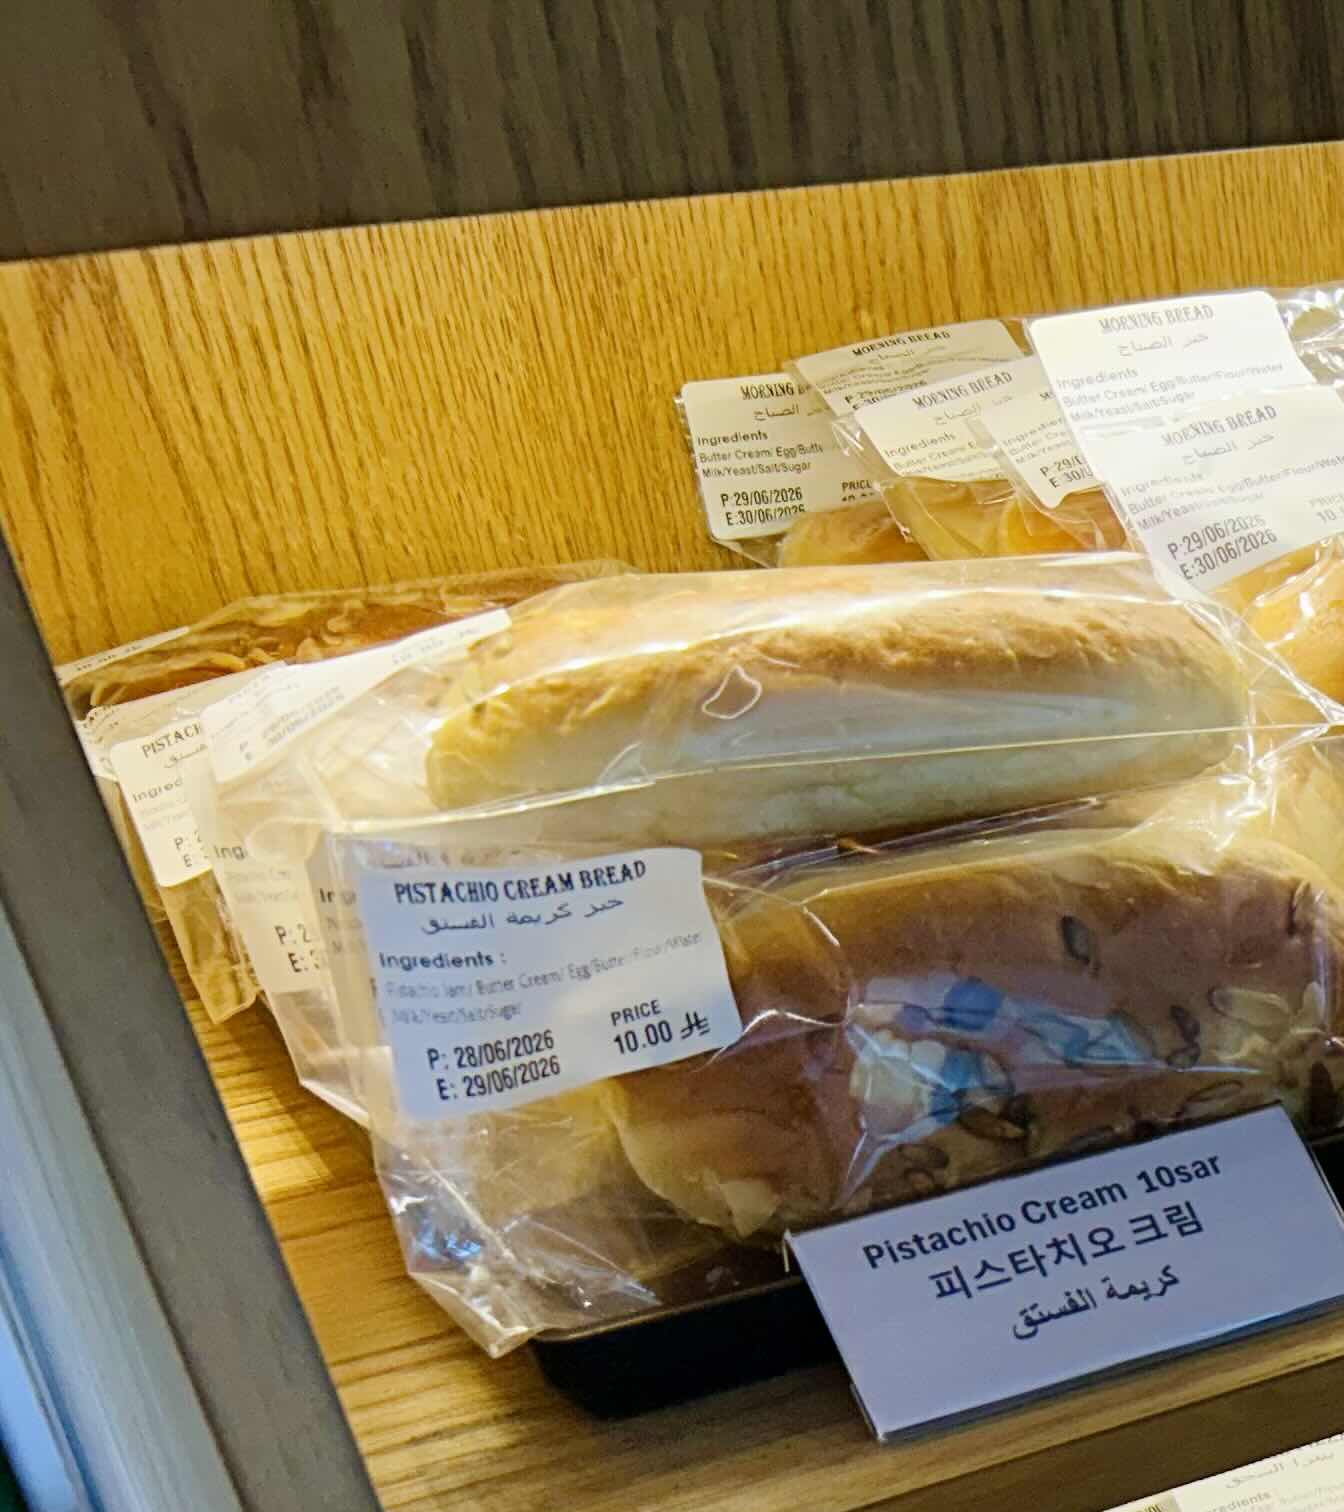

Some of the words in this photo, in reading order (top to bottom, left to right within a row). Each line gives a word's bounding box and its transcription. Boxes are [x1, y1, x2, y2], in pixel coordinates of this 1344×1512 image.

[1099, 311, 1163, 334] MORNING
[1166, 304, 1214, 326] BREAD
[740, 382, 794, 400] MORNING
[912, 385, 967, 411] MORNING
[1160, 420, 1225, 447] MORNING
[1227, 406, 1278, 431] BREAD
[394, 877, 500, 905] PISTACHIO
[504, 871, 574, 900] CREAM
[580, 860, 647, 892] BREAD
[610, 999, 661, 1027] PRICE
[453, 1029, 555, 1067] 28/06/2026
[613, 1019, 673, 1056] 10.00
[462, 1055, 561, 1097] 29/06/2026
[861, 1209, 1017, 1270] Pistachio
[1020, 1176, 1129, 1227] Cream
[1135, 1152, 1223, 1197] 10sar
[928, 1223, 1126, 1300] 피스타치오
[1127, 1199, 1205, 1246] 크림
[1103, 1264, 1181, 1302] كريمة
[1011, 1289, 1099, 1342] الفستق
